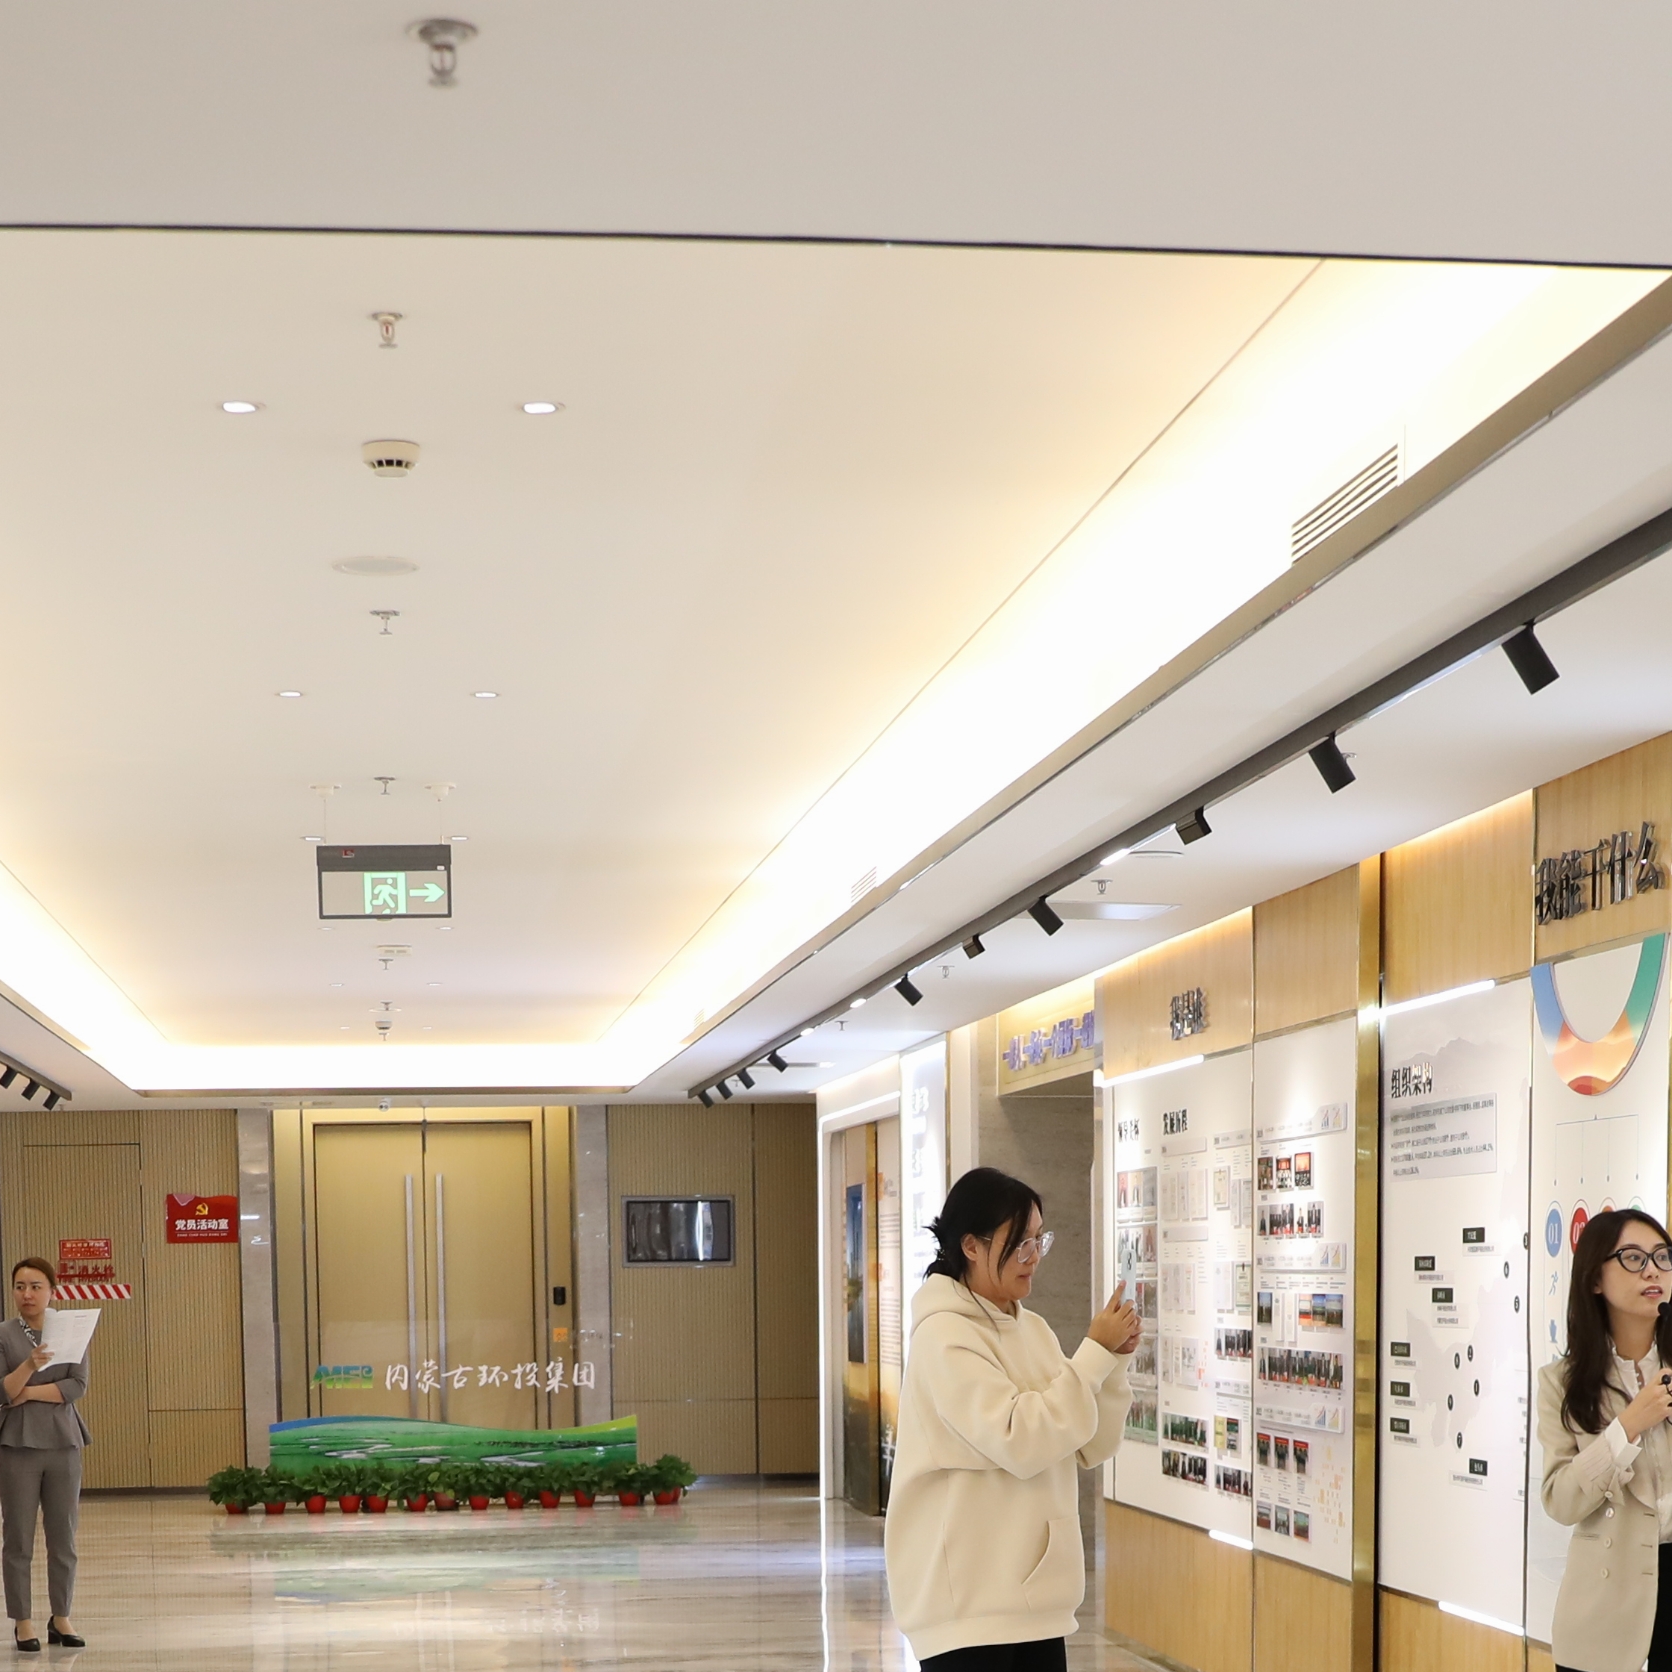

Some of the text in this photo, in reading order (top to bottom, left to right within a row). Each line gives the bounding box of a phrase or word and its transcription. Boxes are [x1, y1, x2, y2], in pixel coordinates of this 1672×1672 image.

[1535, 821, 1665, 925] 我能干什么
[1391, 1062, 1433, 1098] 组织架构
[175, 1218, 229, 1231] 党员活动室
[1548, 1223, 1559, 1244] 01
[384, 1356, 596, 1395] 内蒙古环投集团
